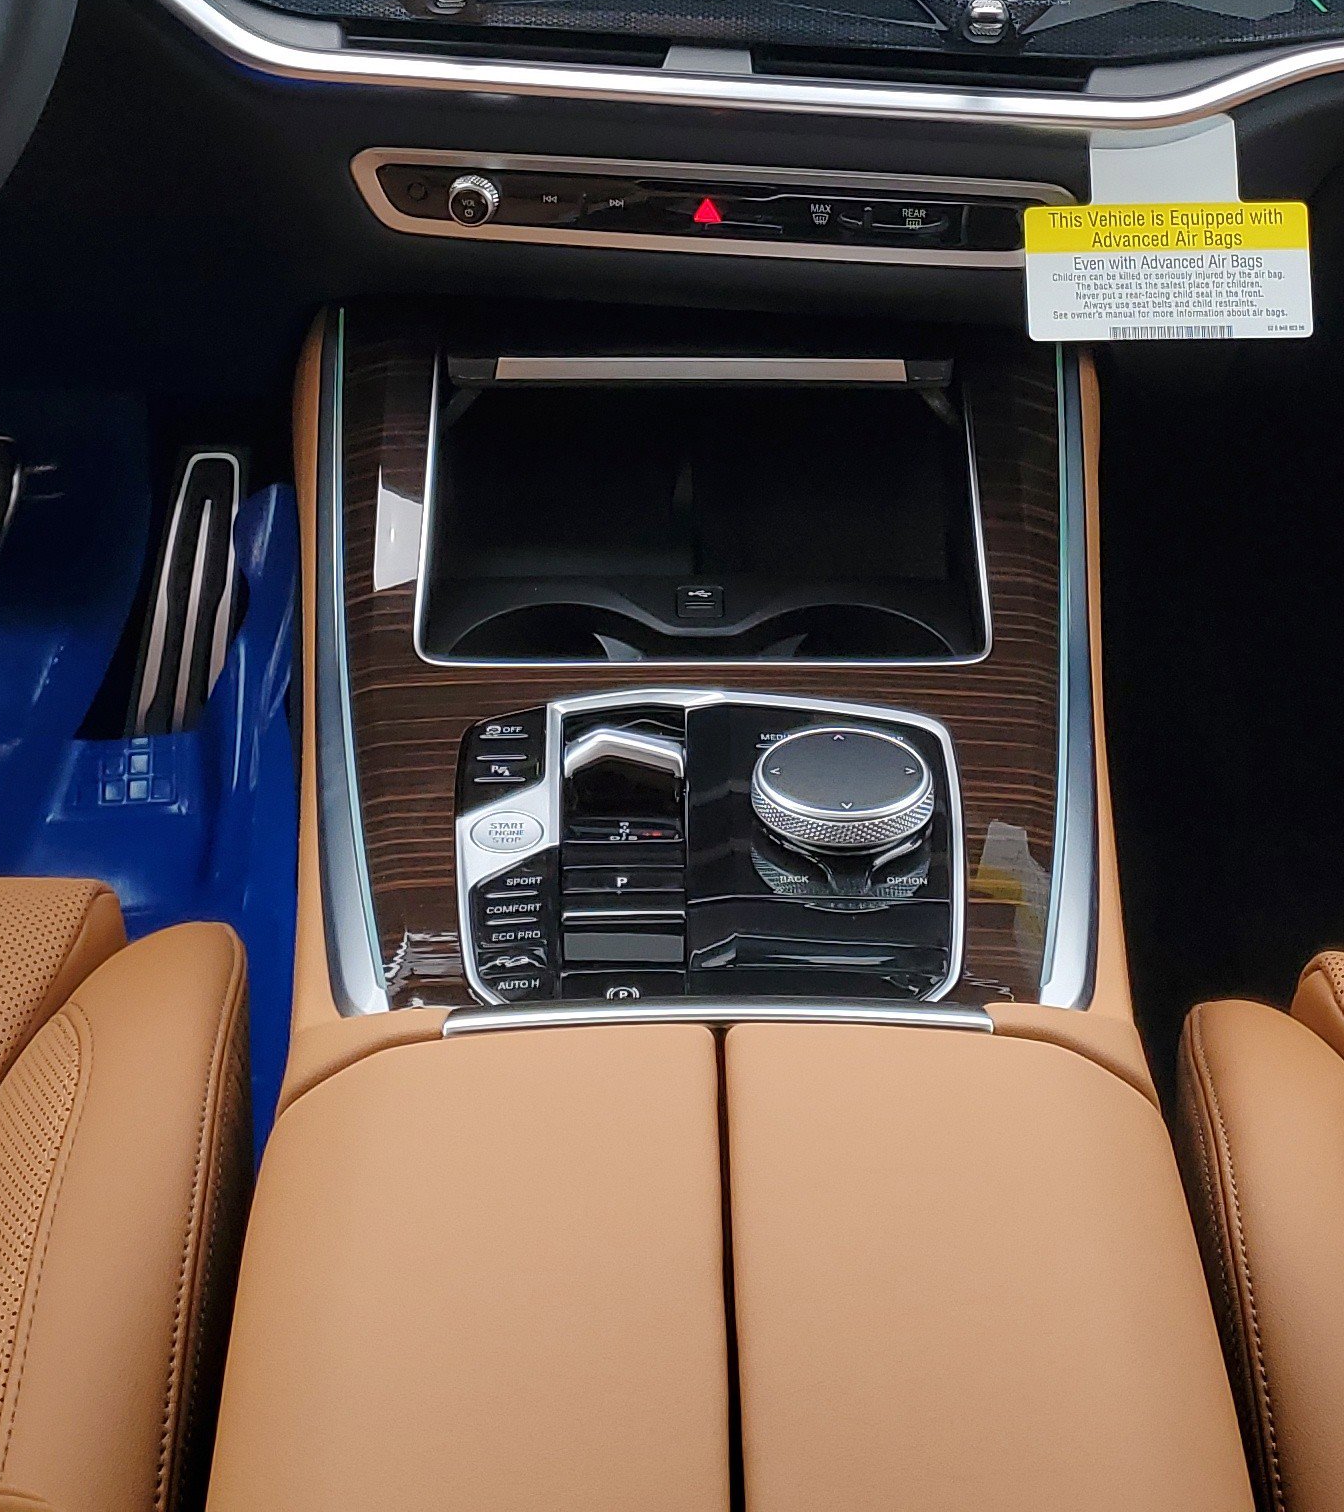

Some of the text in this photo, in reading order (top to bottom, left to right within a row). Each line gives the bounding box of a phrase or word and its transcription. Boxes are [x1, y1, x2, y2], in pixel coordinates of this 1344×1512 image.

[462, 199, 475, 207] VOL
[810, 203, 831, 213] MAX
[902, 208, 926, 218] REAR
[1048, 208, 1283, 229] This Vehicle is Equipped with
[1092, 230, 1243, 249] Advanced Air Bags
[1073, 254, 1263, 271] Even with Advanced Air Bags
[1052, 270, 1285, 282] Children can be killed or seriously injured by the air bag.
[1076, 282, 1091, 290] The
[1093, 282, 1113, 290] back
[1115, 282, 1132, 290] seat
[1145, 281, 1157, 289] the
[1160, 281, 1185, 289] safest
[1188, 281, 1210, 291] place
[1213, 280, 1224, 289] for
[1226, 279, 1262, 289] children.
[1075, 292, 1100, 300] Never
[1102, 292, 1116, 301] put
[1125, 291, 1170, 301] rear-facing
[1173, 290, 1192, 299] child
[1195, 290, 1212, 299] seat
[1226, 290, 1238, 298] the
[1241, 289, 1264, 298] front.
[1083, 302, 1113, 311] Always
[1132, 301, 1149, 309] seat
[1152, 300, 1172, 309] belts
[1175, 299, 1189, 308] and
[1192, 299, 1212, 308] child
[1215, 298, 1257, 308] restraints.
[1053, 307, 1288, 320] See owner's manual for more information about air bags.
[502, 726, 523, 734] OFF
[506, 876, 543, 886] SPORT
[616, 877, 628, 888] P
[887, 876, 928, 885] OPTION
[486, 903, 542, 914] COMFORT
[492, 930, 541, 941] ECO PRO
[498, 978, 540, 990] AUTO H
